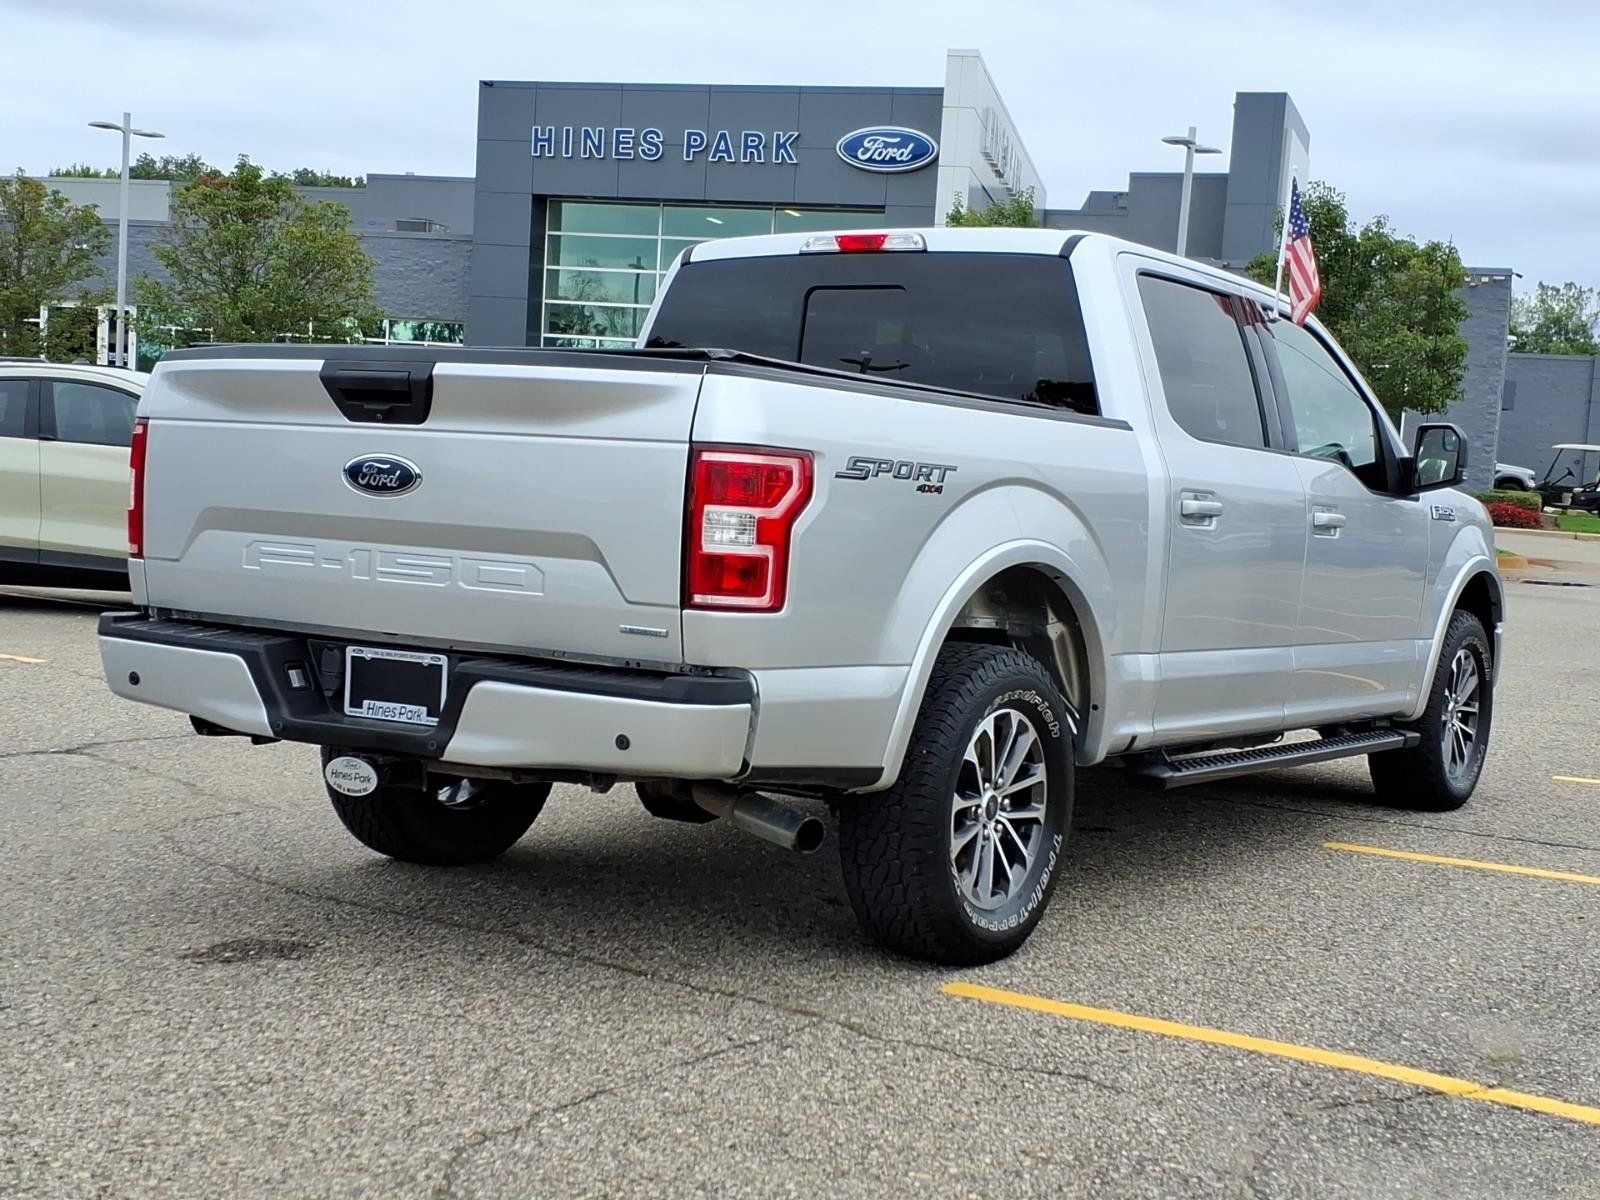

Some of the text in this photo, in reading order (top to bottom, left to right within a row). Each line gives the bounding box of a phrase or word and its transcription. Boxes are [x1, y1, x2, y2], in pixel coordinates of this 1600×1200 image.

[531, 126, 799, 164] HINES PARK
[857, 135, 914, 161] Ford
[358, 461, 401, 487] Ford
[834, 455, 958, 483] SPORT
[242, 540, 545, 596] F-150
[366, 702, 423, 722] Hines Park
[331, 768, 371, 783] Hines Park
